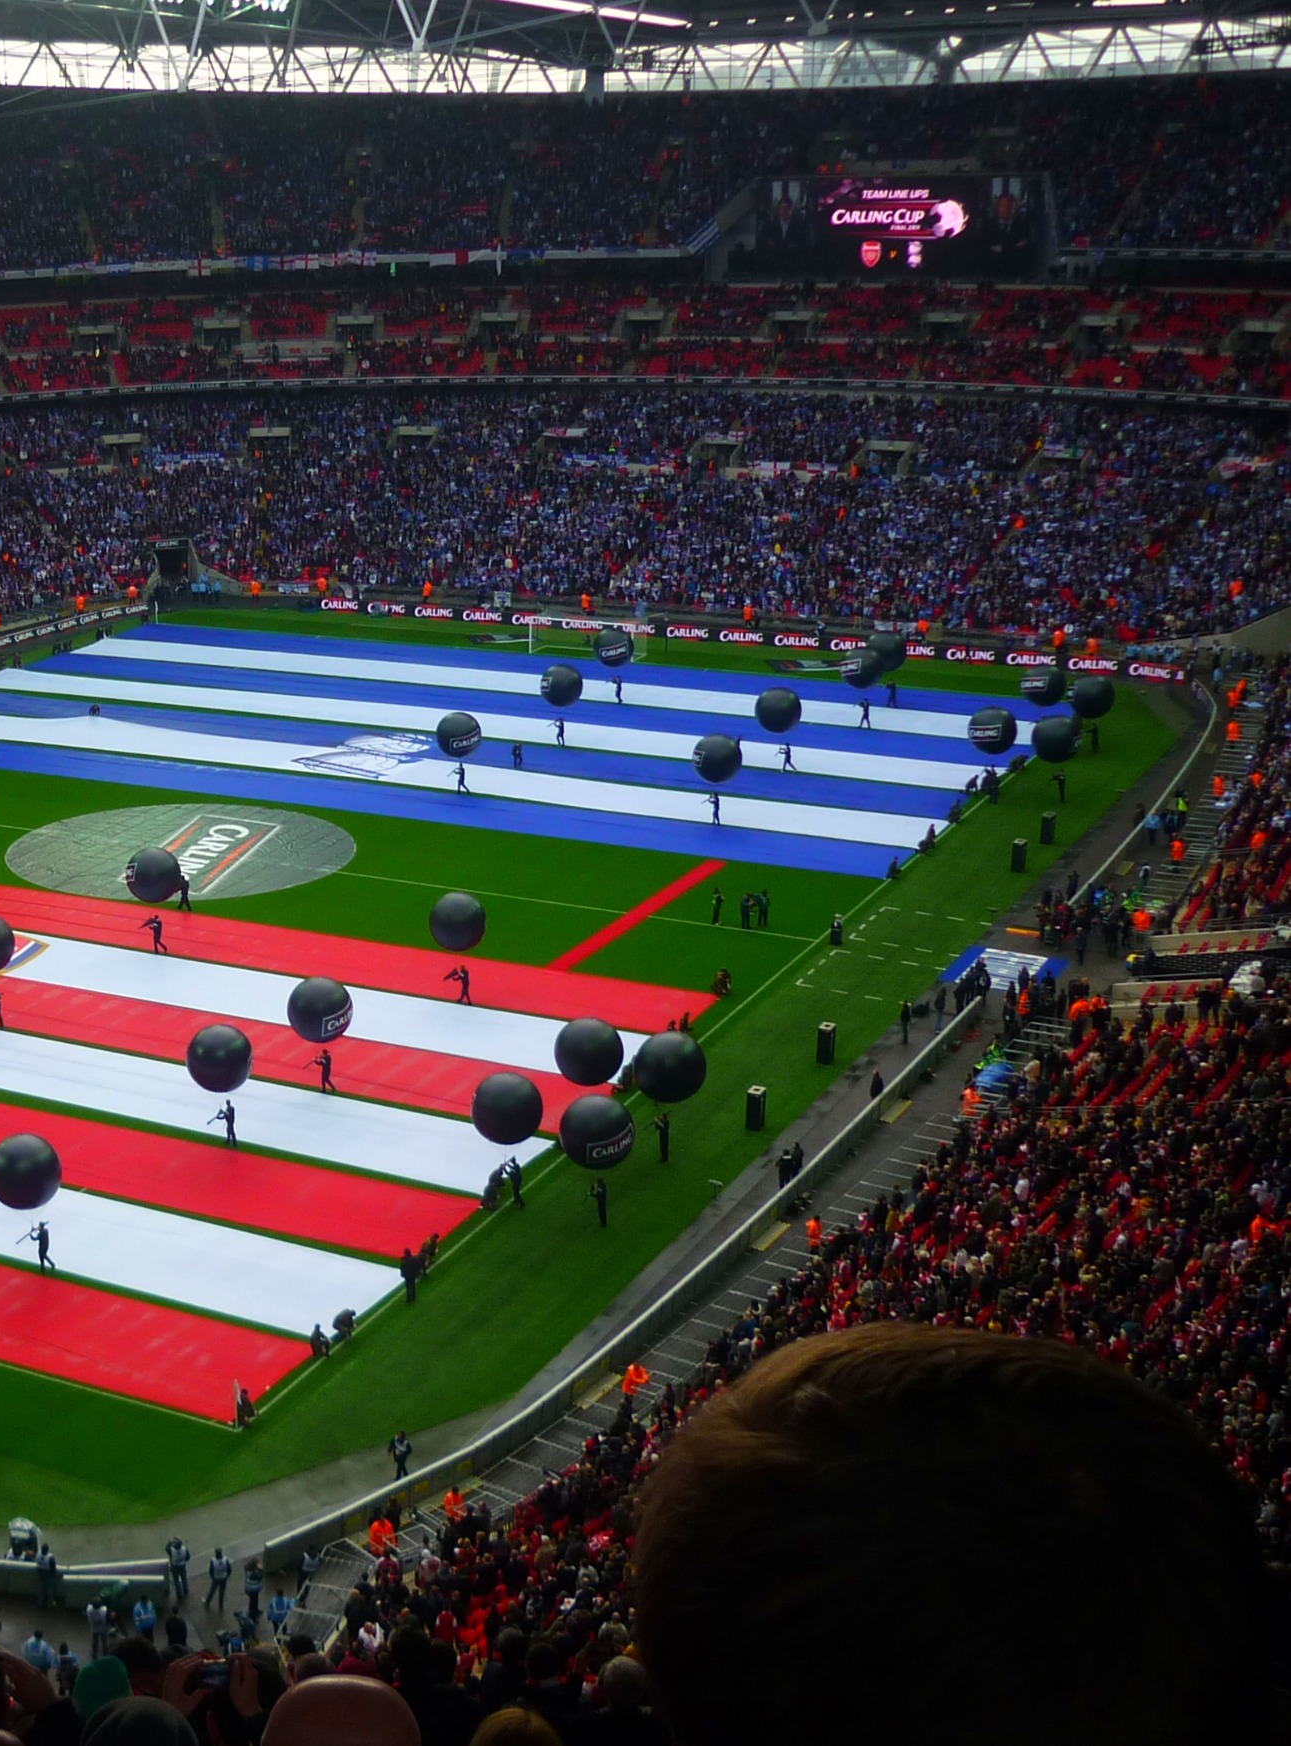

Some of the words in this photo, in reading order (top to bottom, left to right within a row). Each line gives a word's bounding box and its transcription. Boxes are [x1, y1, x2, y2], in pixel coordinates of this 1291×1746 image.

[862, 189, 888, 200] TEAM
[888, 189, 909, 199] LINE
[909, 188, 930, 199] UPS
[831, 209, 893, 226] CARLING
[894, 208, 926, 224] CUP
[320, 599, 359, 610] CARLING
[414, 606, 453, 618] CARLING
[462, 610, 502, 622] CARLING
[511, 614, 552, 626] CARLING
[562, 618, 603, 630] CARLING
[666, 627, 709, 638] CARLING
[719, 630, 764, 642] CARLING
[774, 634, 820, 648] CARLING
[601, 646, 628, 659] CARLING
[1006, 652, 1057, 666] CARLING
[1068, 658, 1118, 671] CARLING
[1129, 664, 1171, 679] CARLING
[178, 824, 250, 880] CARLIN
